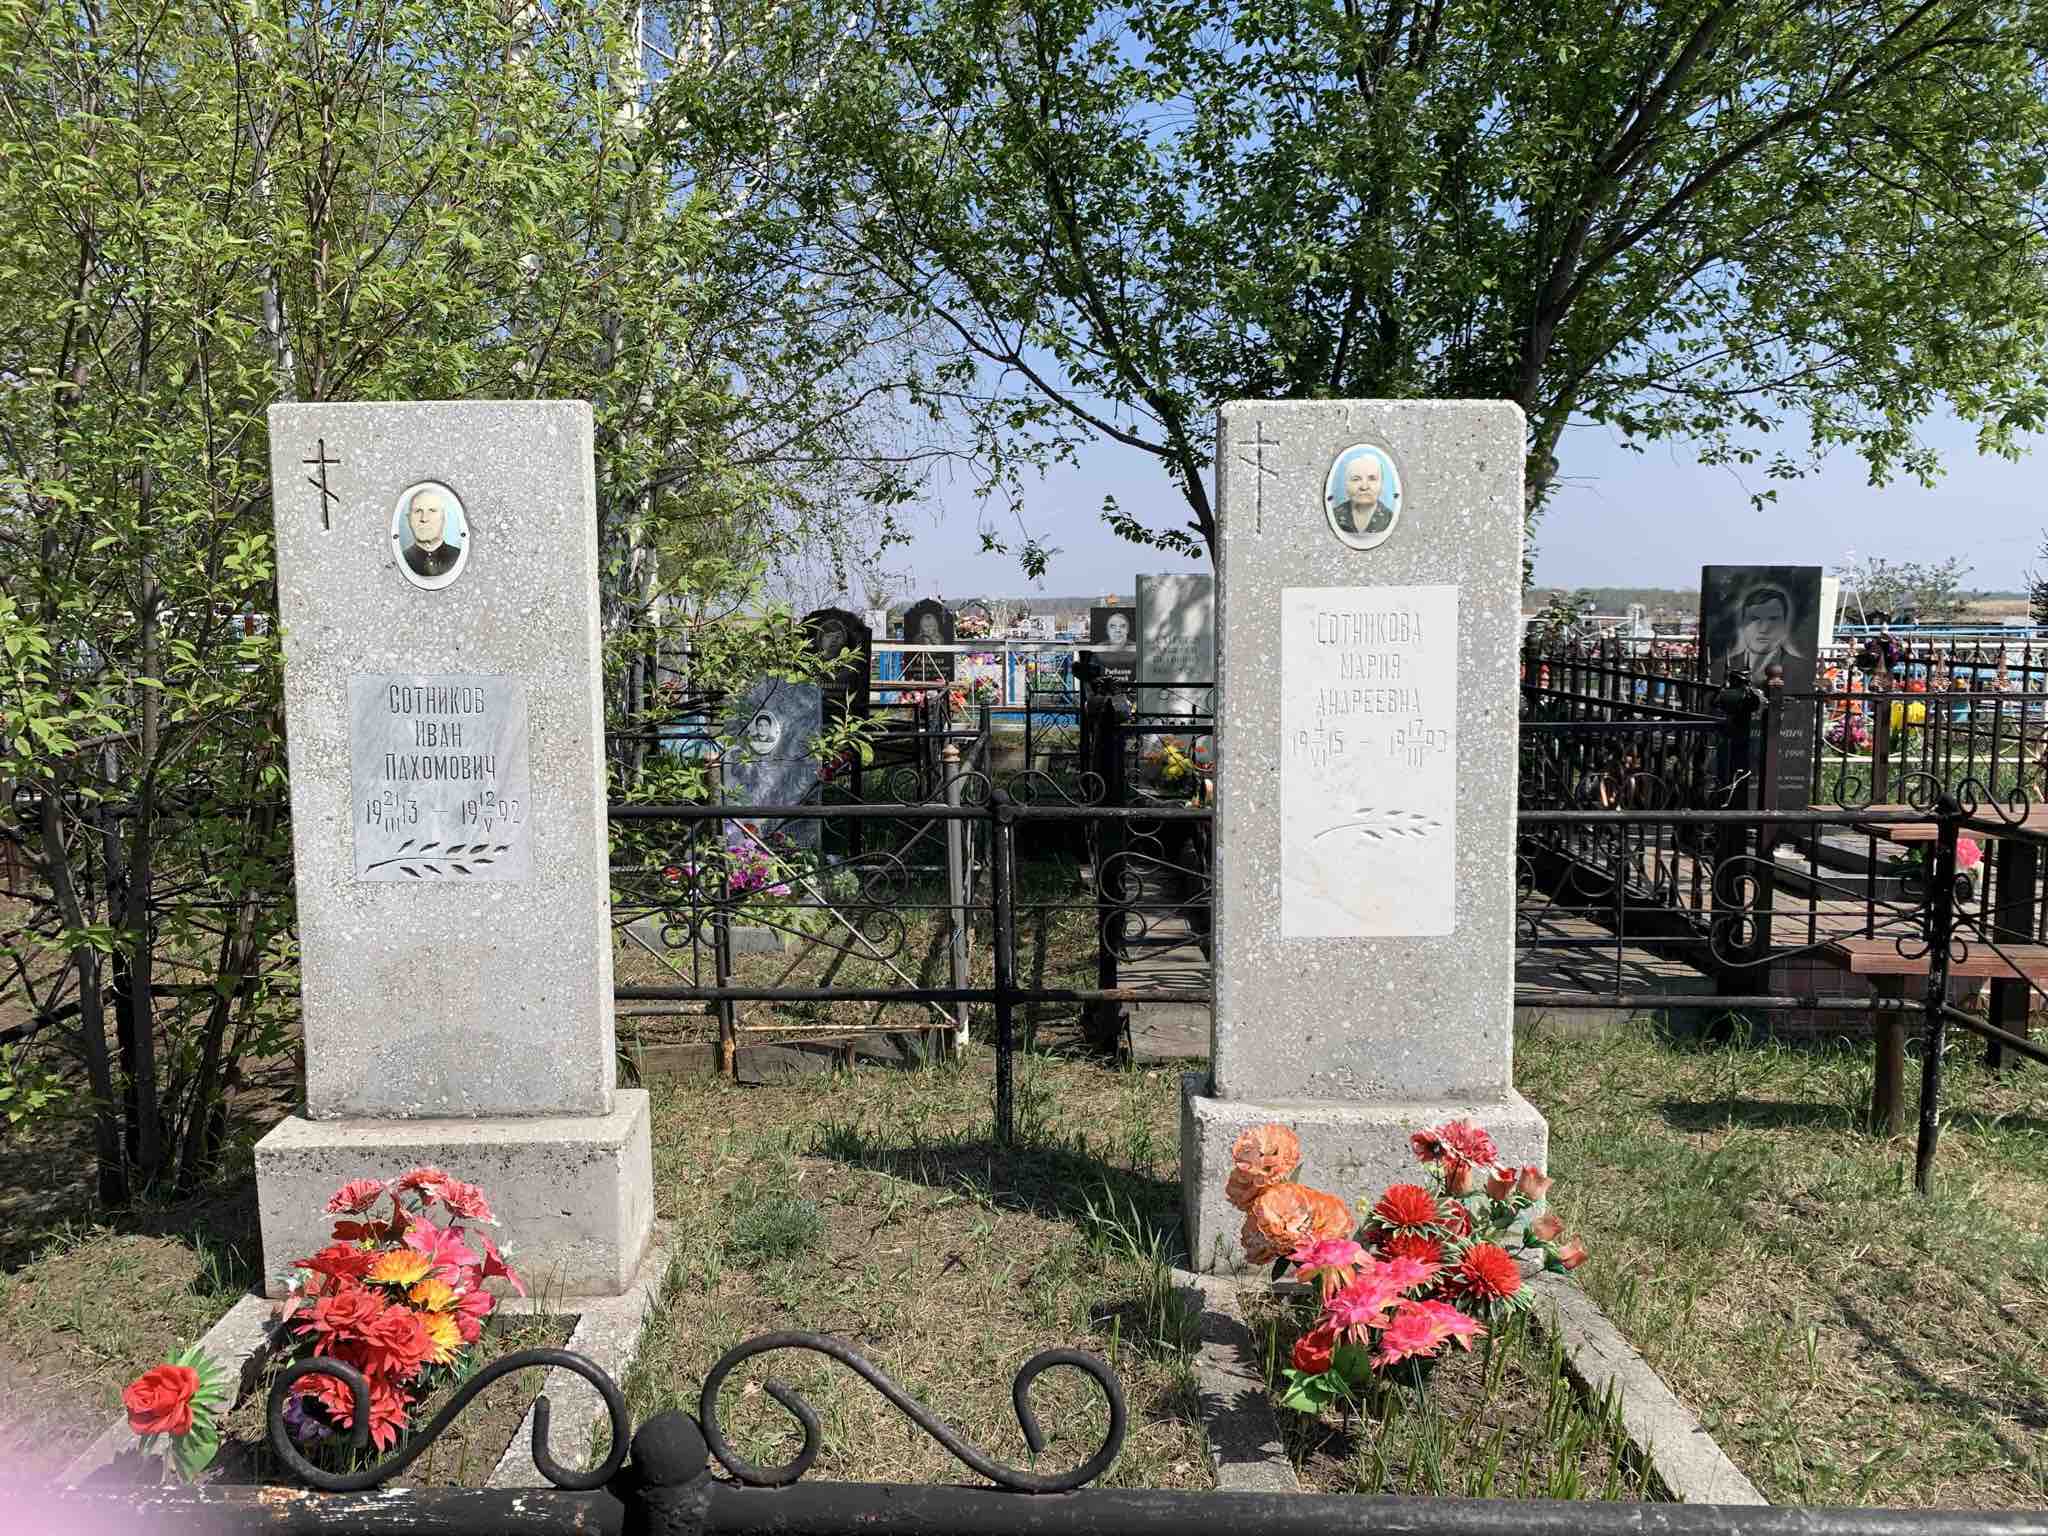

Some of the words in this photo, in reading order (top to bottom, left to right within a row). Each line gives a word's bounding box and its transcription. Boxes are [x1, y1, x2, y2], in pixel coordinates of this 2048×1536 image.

[1316, 612, 1424, 645] СОТНИКОВА
[1340, 651, 1401, 681] МАРИЯ
[389, 684, 485, 715] СОТНИКОВ
[1317, 686, 1423, 716] АНДРЕЕВНА
[415, 719, 462, 748] ИВАН
[384, 753, 496, 781] ПАХОМОВИЧ
